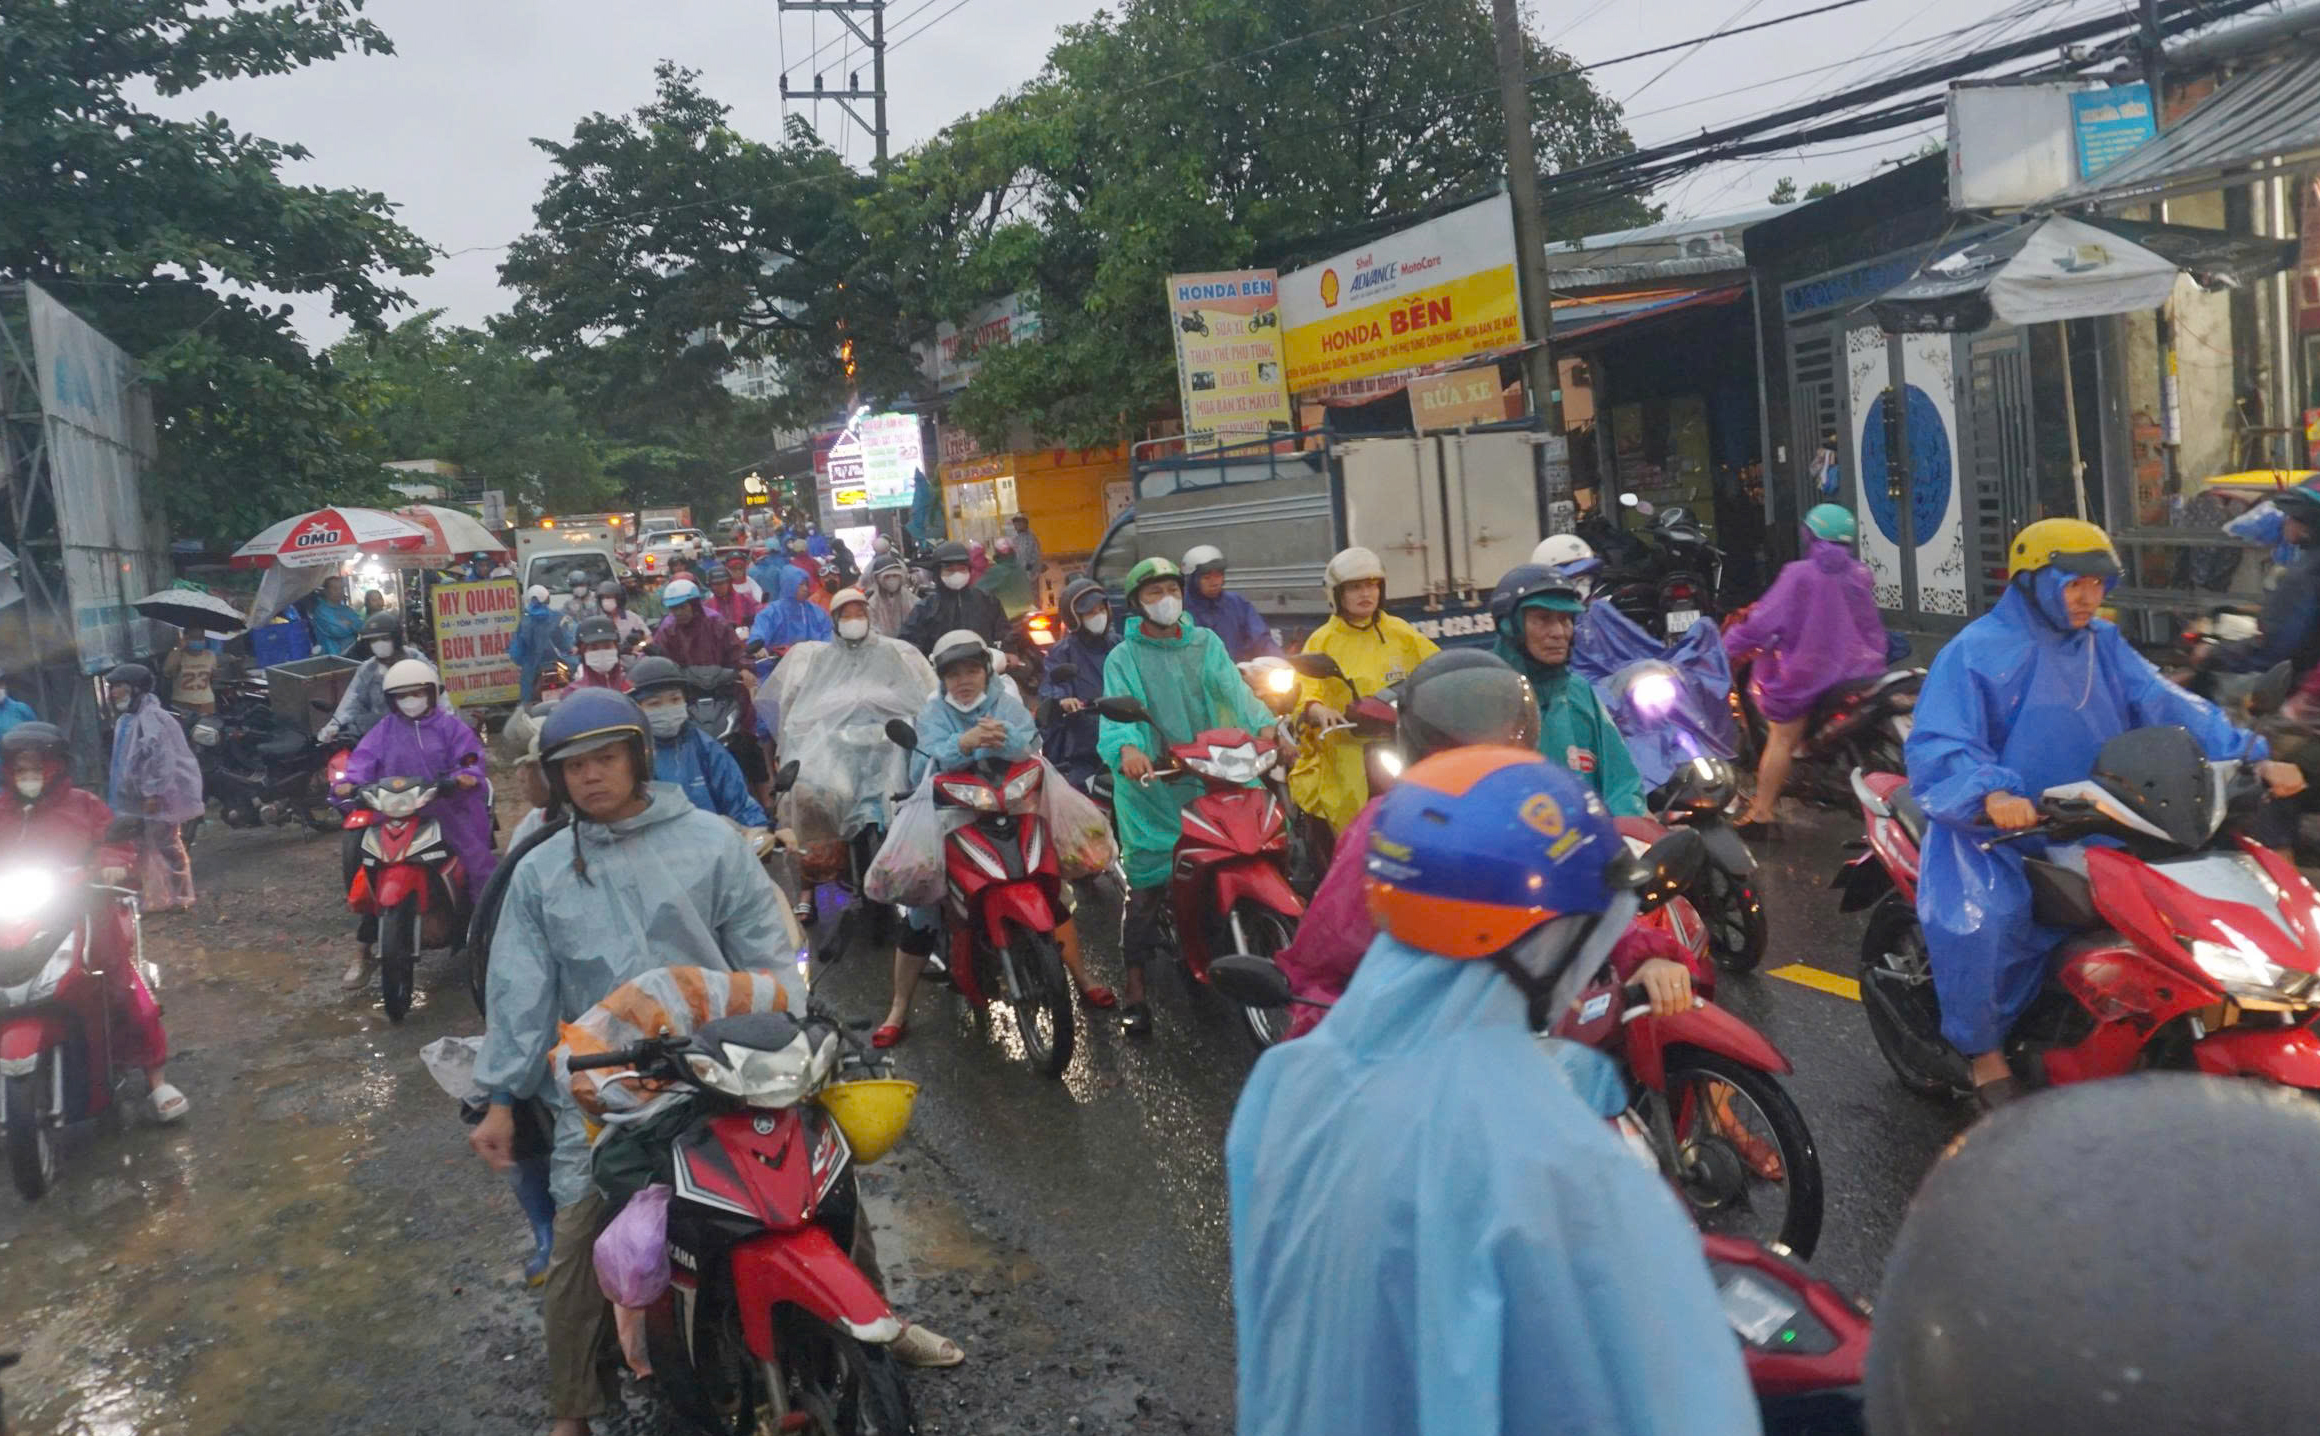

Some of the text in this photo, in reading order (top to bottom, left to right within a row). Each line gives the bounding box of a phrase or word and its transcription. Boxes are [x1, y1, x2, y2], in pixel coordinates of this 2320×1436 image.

[1356, 253, 1373, 270] Shell
[1401, 255, 1441, 274] MotoCare
[1349, 262, 1397, 293] ADVANCE
[1178, 282, 1238, 301] HONDA
[1321, 295, 1452, 353] HONDA BỀN
[1466, 382, 1493, 402] XE
[297, 531, 339, 547] OMO
